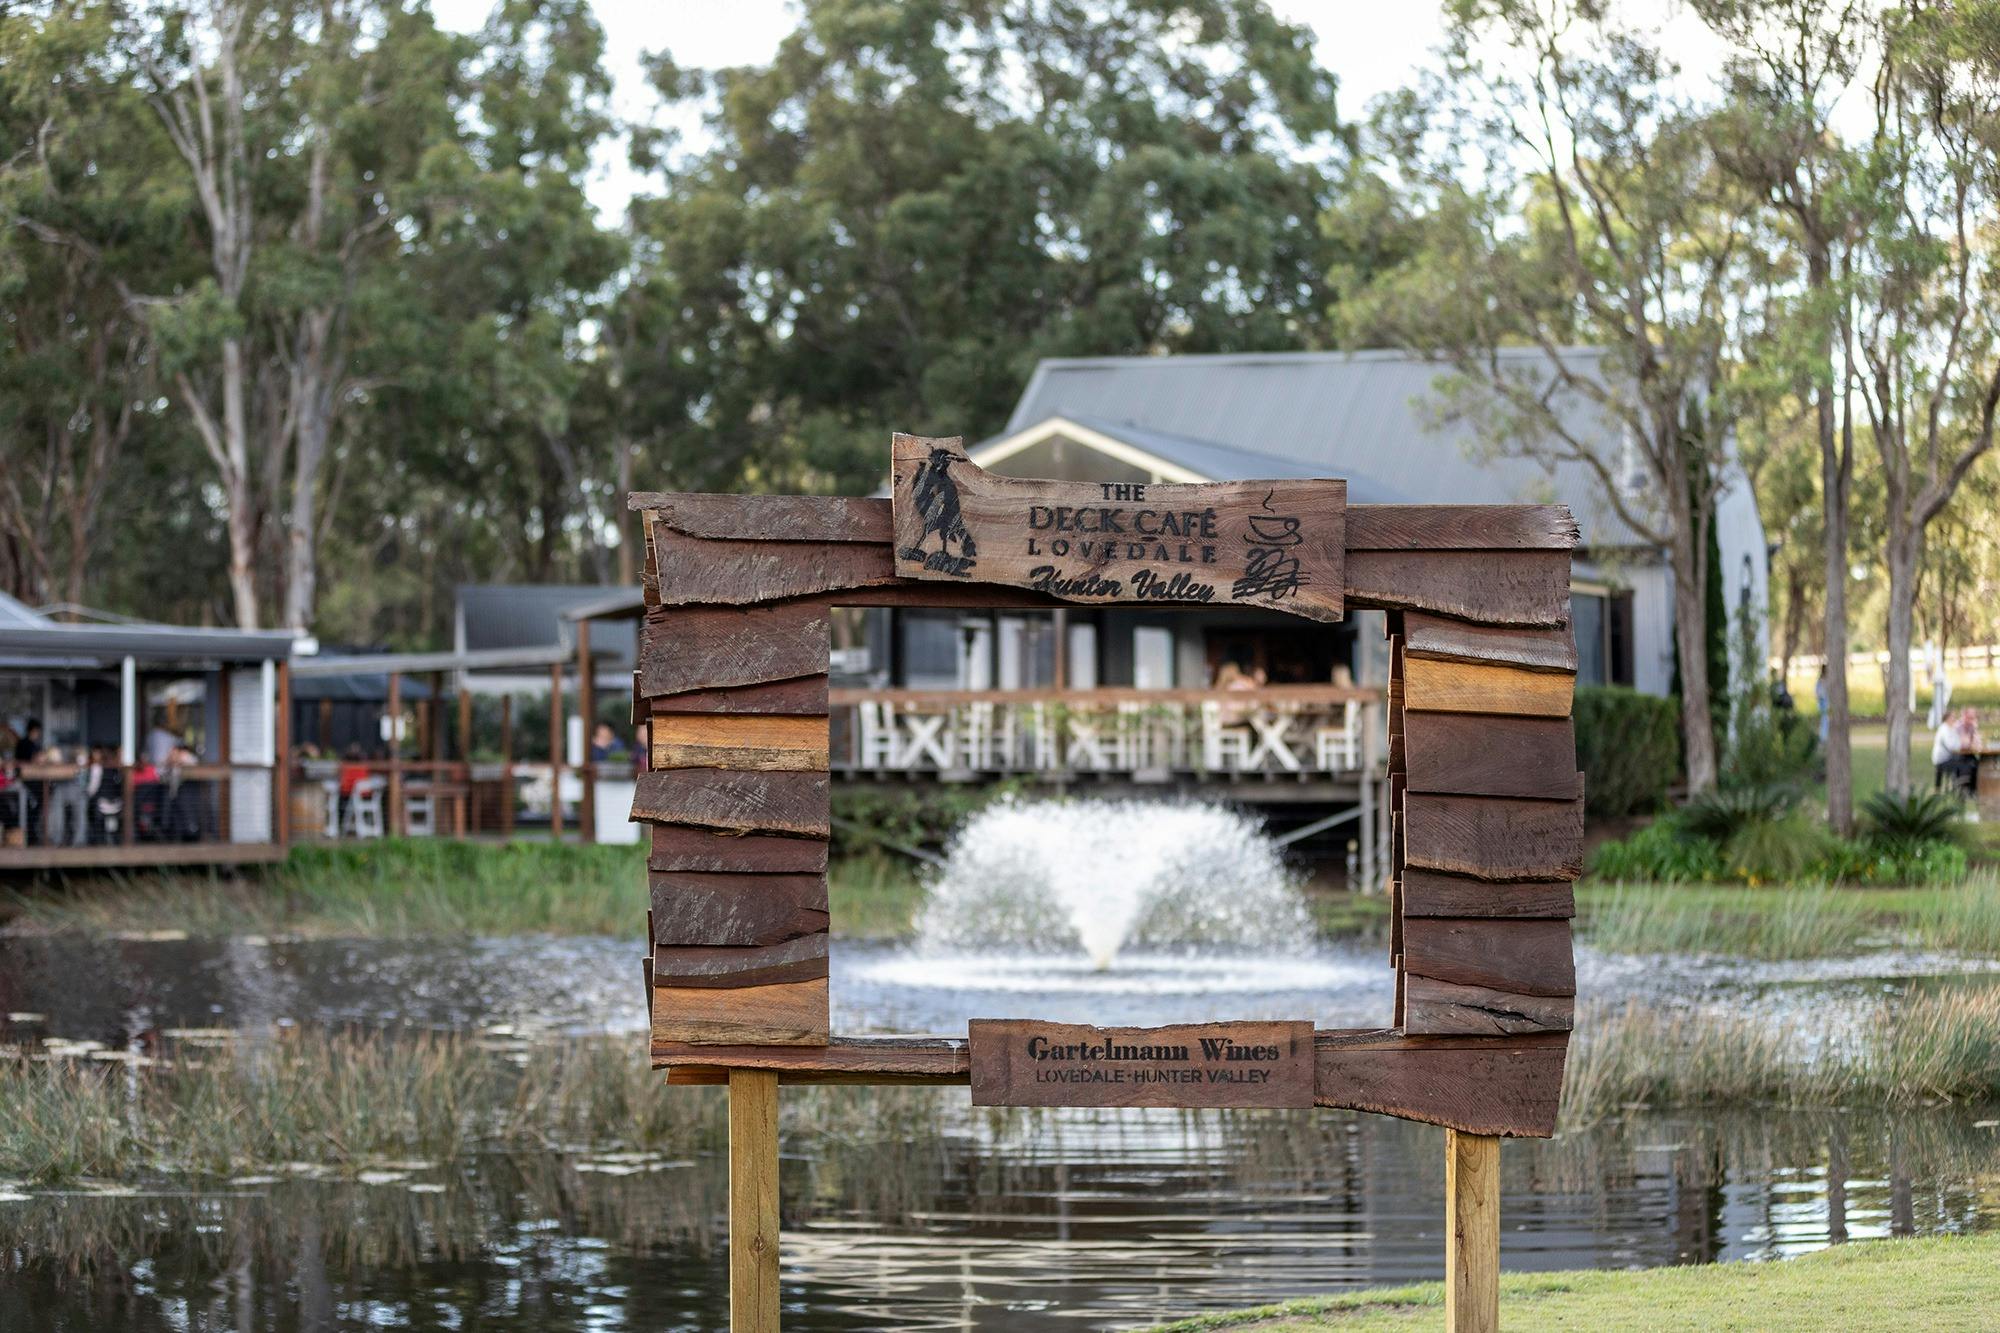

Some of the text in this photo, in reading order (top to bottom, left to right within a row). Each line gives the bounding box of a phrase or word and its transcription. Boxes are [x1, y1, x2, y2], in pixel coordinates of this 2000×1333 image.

[1100, 483, 1146, 502] THE
[1029, 506, 1217, 539] DECK CAFÉ
[1028, 538, 1216, 564] LOVEDALE
[1029, 565, 1216, 603] Hunter Valley
[1027, 1036, 1280, 1062] Gartelmann Wines
[1208, 1069, 1271, 1084] VALLEY
